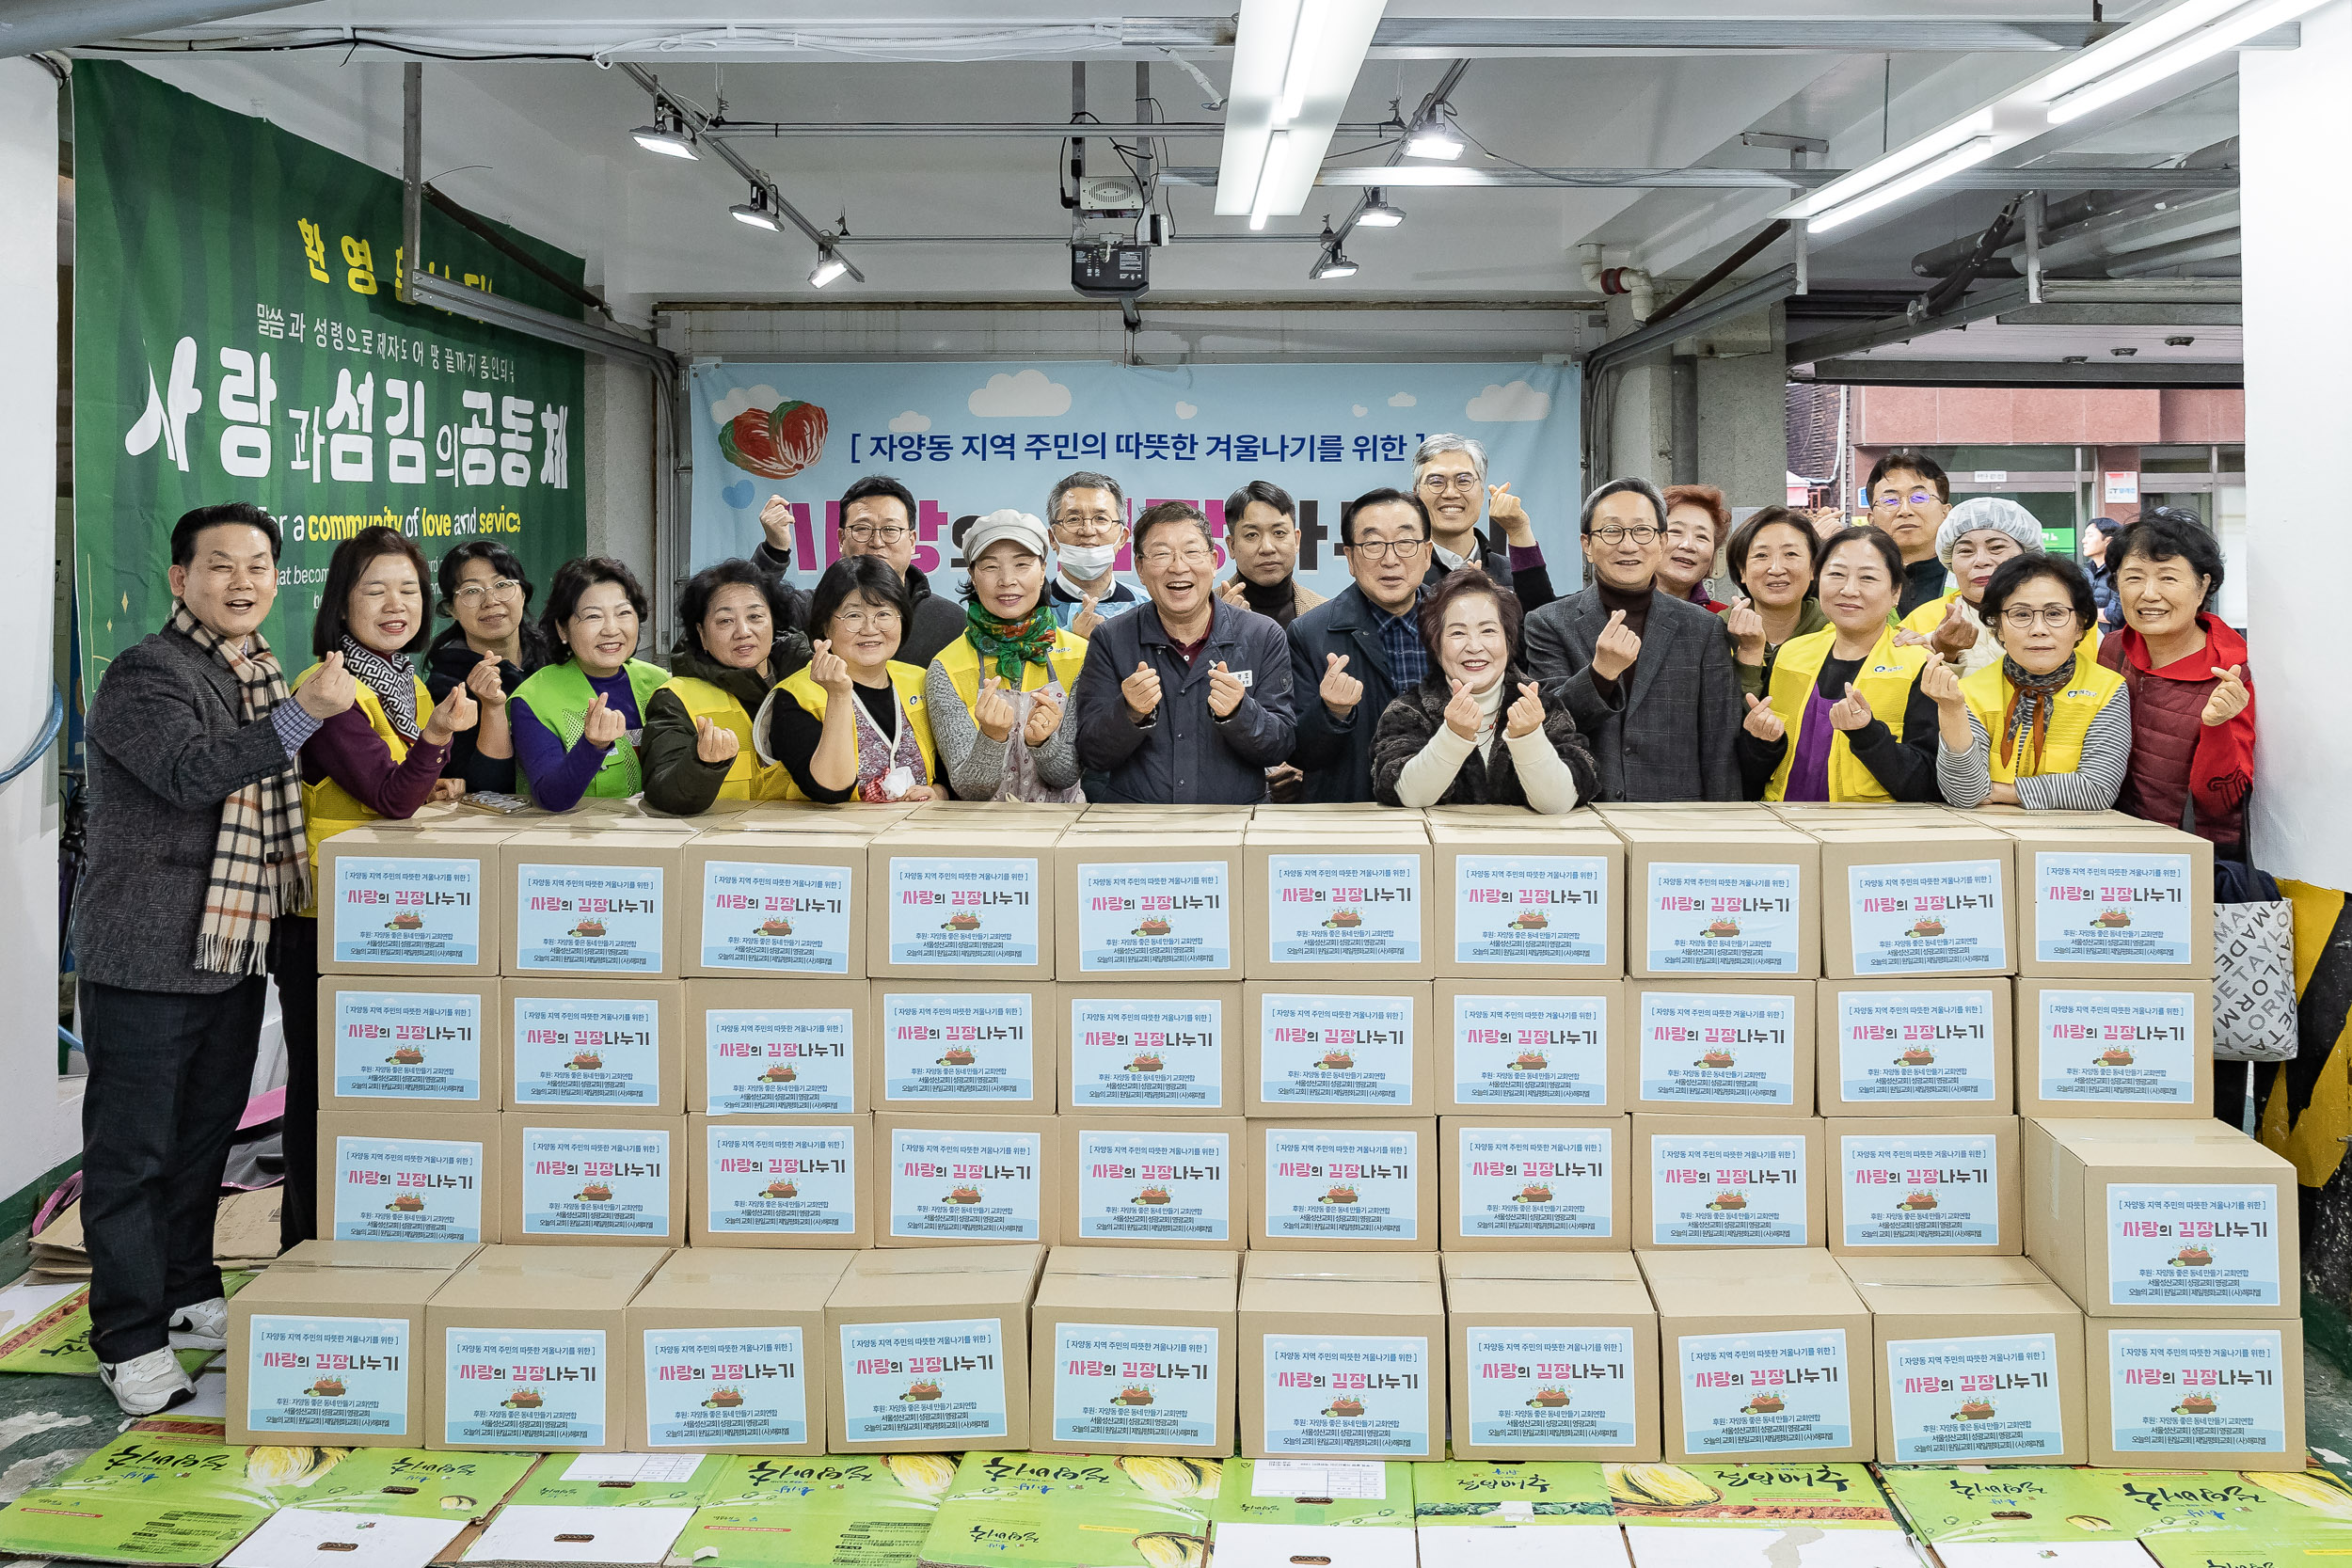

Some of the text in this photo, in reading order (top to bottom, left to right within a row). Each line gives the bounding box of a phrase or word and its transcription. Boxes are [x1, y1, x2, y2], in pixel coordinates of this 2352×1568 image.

[313, 317, 373, 355] 성령으로
[460, 388, 568, 489] 공동체
[869, 434, 954, 462] 자양동
[961, 433, 1015, 461] 지역
[1024, 432, 1106, 460] 주민의
[1116, 432, 1199, 461] 따뜻한
[1205, 434, 1344, 462] 겨울나기를
[1352, 434, 1407, 462] 위한
[405, 506, 420, 538] of
[421, 507, 452, 537] love
[347, 889, 470, 905] 사랑의 김장나누기
[902, 890, 1028, 905] 사랑의 김장나누기
[1282, 887, 1410, 902] 사랑의 김장나누기
[1469, 888, 1597, 904] 사랑의 김장나누기
[1864, 893, 1993, 911] 사랑의 김장나누기
[2049, 885, 2181, 902] 사랑의 김장나누기
[531, 896, 653, 913] 사랑의 김장나누기
[716, 894, 841, 912] 사랑의 김장나누기
[1091, 894, 1219, 911] 사랑의 김장나누기
[1661, 895, 1789, 911] 사랑의 김장나누기
[348, 1023, 470, 1040] 사랑의 김장나누기
[527, 1029, 649, 1045] 사랑의 김장나누기
[898, 1025, 1023, 1039] 사랑의 김장나누기
[1085, 1031, 1212, 1046] 사랑의 김장나누기
[1275, 1027, 1403, 1044] 사랑의 김장나누기
[1468, 1029, 1597, 1044] 사랑의 김장나누기
[1654, 1026, 1784, 1043] 사랑의 김장나누기
[1852, 1023, 1983, 1039] 사랑의 김장나누기
[2053, 1023, 2184, 1040] 사랑의 김장나누기
[719, 1042, 843, 1056] 사랑의 김장나누기
[535, 1161, 660, 1177] 사랑의 김장나누기
[721, 1158, 845, 1173] 사랑의 김장나누기
[904, 1163, 1030, 1180] 사랑의 김장나누기
[1092, 1164, 1219, 1180] 사랑의 김장나누기
[1279, 1162, 1407, 1179] 사랑의 김장나누기
[1472, 1161, 1602, 1177] 사랑의 김장나누기
[348, 1170, 472, 1189] 사랑의 김장나누기
[1665, 1168, 1796, 1183] 사랑의 김장나누기
[1855, 1168, 1987, 1183] 사랑의 김장나누기
[2122, 1221, 2266, 1237] 사랑의 김장나누기
[1483, 1342, 1617, 1352] 자양동 지역 주민의 따뜻한 겨울나기를 위한
[263, 1352, 398, 1370] 사랑의 김장나누기
[856, 1354, 993, 1374] 사랑의 김장나누기
[1069, 1360, 1207, 1379] 사랑의 김장나누기
[459, 1364, 596, 1381] 사랑의 김장나누기
[659, 1362, 794, 1380] 사랑의 김장나누기
[1278, 1371, 1418, 1388] 사랑의 김장나누기
[1482, 1363, 1623, 1379] 사랑의 김장나누기
[1695, 1366, 1837, 1386] 사랑의 김장나누기
[2125, 1368, 2272, 1385] 사랑의 김장나누기
[1905, 1371, 2047, 1393] 사랑의 김장나누기
[1497, 1409, 1513, 1418] 후원:
[1514, 1409, 1533, 1418] 자양동
[1506, 1428, 1518, 1436] 교회
[1713, 1465, 1850, 1493] 절임배추
